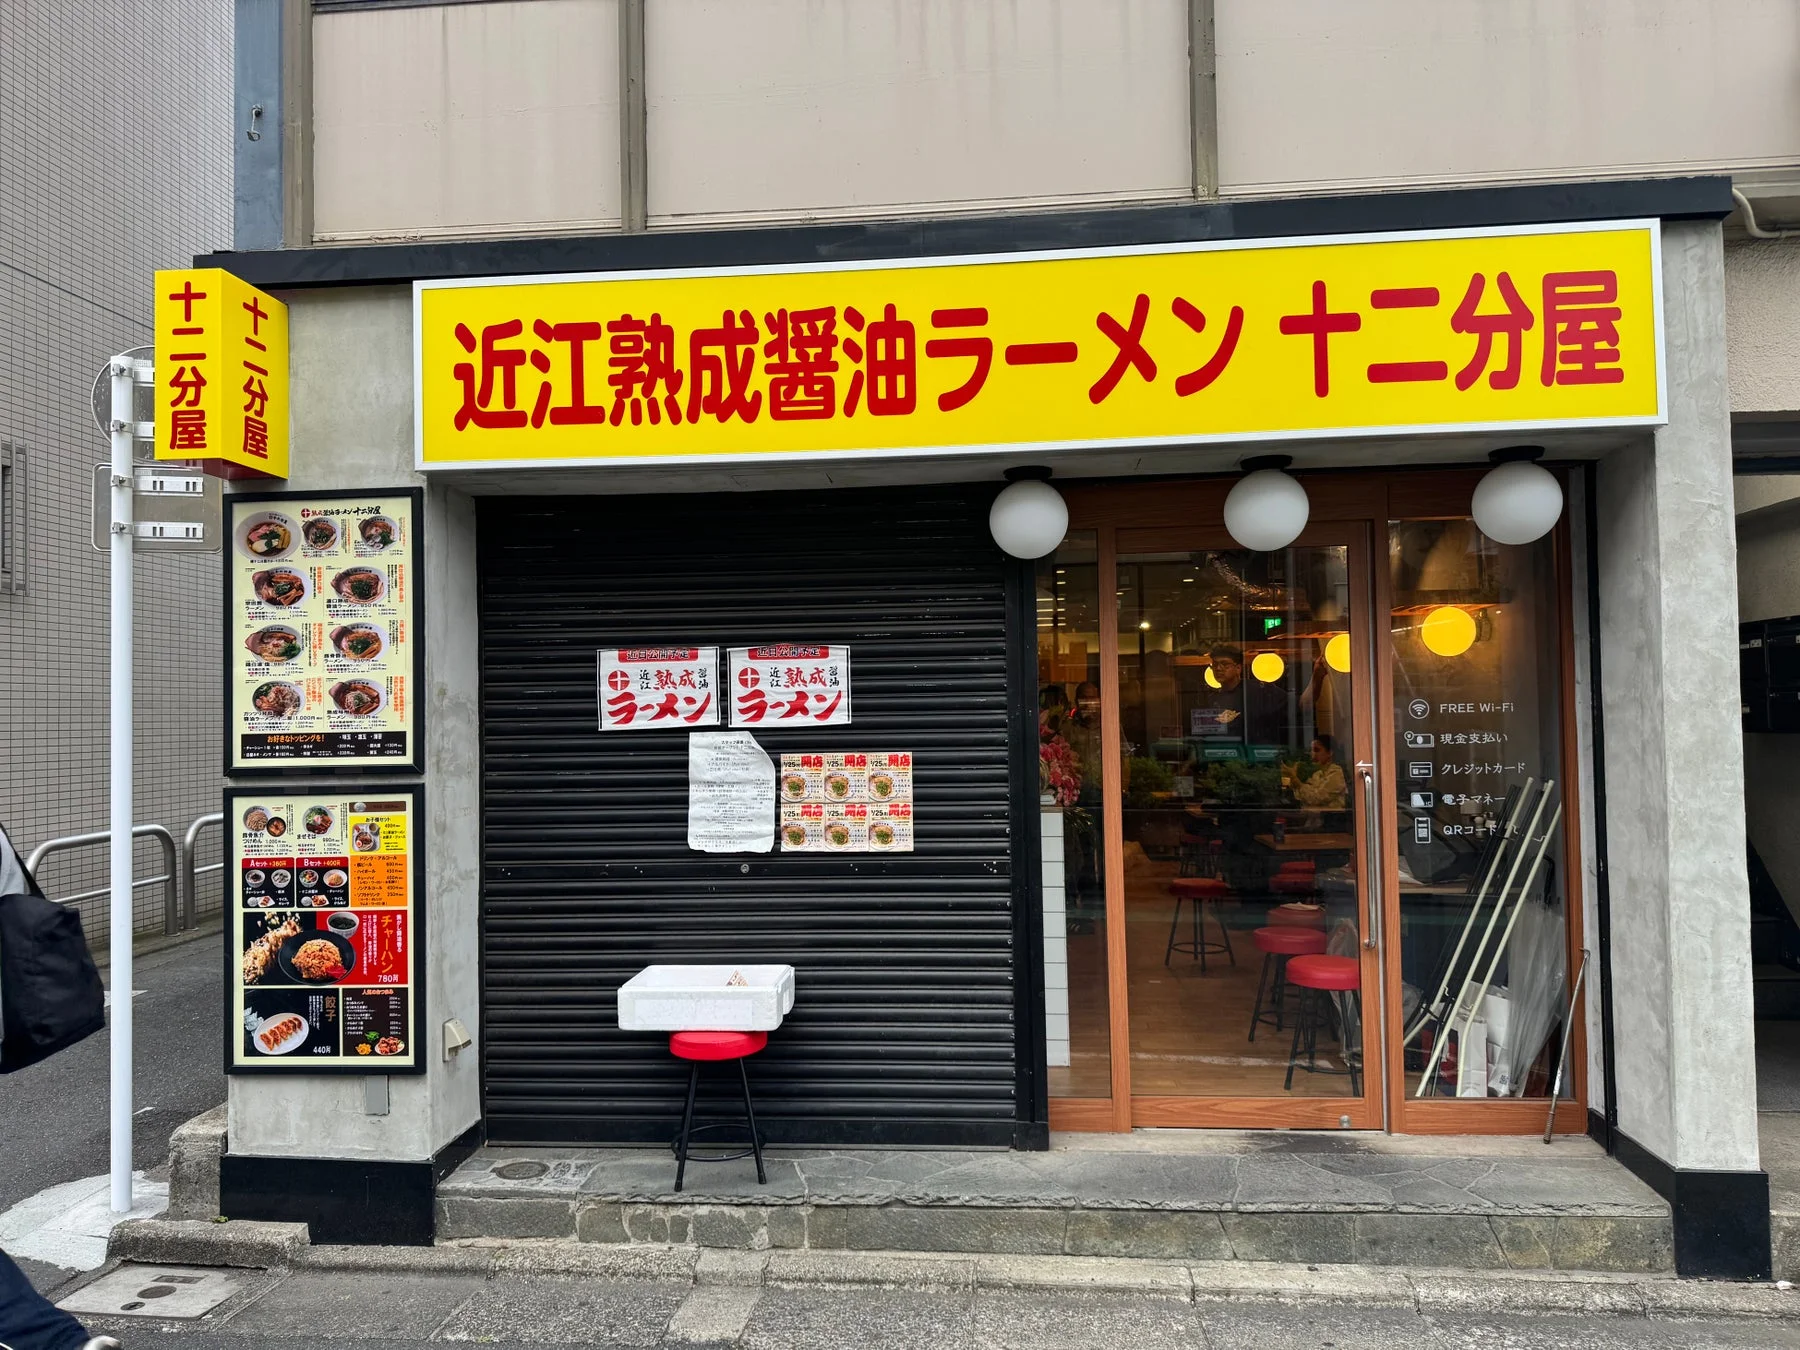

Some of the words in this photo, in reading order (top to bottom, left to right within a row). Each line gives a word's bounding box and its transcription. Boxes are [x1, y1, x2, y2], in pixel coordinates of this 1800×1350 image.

[454, 294, 1244, 431] 近江熟成醤油ラーメン
[1279, 271, 1624, 398] 十二分屋
[169, 282, 207, 449] 十二分屋
[243, 296, 268, 459] 十二分屋
[639, 669, 652, 690] 近江
[653, 669, 697, 690] 熟成
[769, 666, 781, 688] 近江
[783, 666, 827, 688] 熟成
[606, 691, 711, 725] ラーメン
[737, 688, 842, 723] ラーメン
[1440, 703, 1475, 713] FREE
[1479, 702, 1514, 712] Wi-Fi
[1440, 733, 1508, 744] 現金支払い
[801, 755, 823, 768] 開店
[844, 754, 867, 767] 開店
[888, 754, 911, 767] 開店
[1441, 762, 1526, 776] クレジットカード
[1442, 793, 1506, 805] 電子マネー
[1443, 825, 1497, 836] QRコード
[381, 915, 394, 974] チャーハン
[377, 974, 399, 983] 780円
[325, 996, 337, 1022] 餃子
